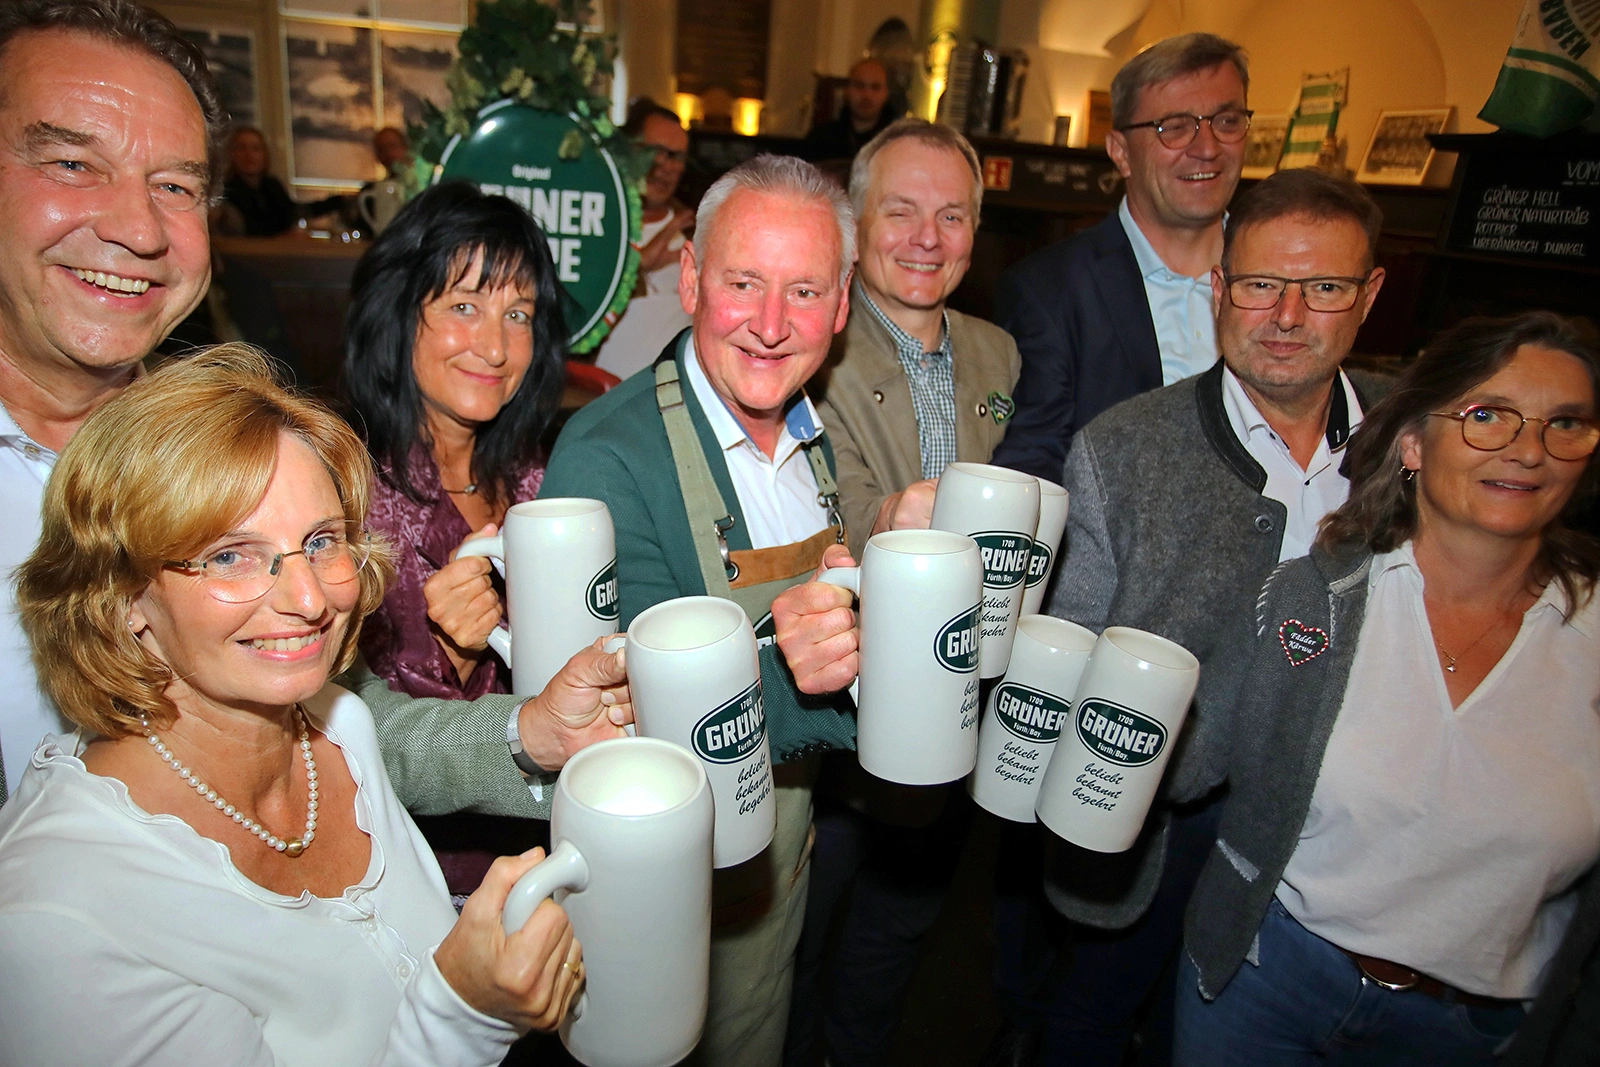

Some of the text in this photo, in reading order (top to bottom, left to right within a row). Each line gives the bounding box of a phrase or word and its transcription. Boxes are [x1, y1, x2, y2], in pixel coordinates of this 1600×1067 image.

[511, 164, 551, 181] Original
[1532, 190, 1560, 207] HELL
[1543, 240, 1586, 257] DUNKEL
[1002, 539, 1015, 548] 1709
[981, 546, 1030, 573] RÜNER
[998, 690, 1068, 731] GRÜNER
[1028, 695, 1044, 706] 1709
[705, 696, 766, 752] GRÜNE
[1081, 706, 1160, 755] GRÜNER
[1117, 714, 1134, 726] 1709
[1003, 741, 1040, 761] beliebt
[997, 752, 1040, 774] bekannt
[1084, 762, 1124, 785] beliebt
[994, 764, 1036, 786] begehrt
[1075, 773, 1123, 799] bekannt
[1071, 787, 1117, 812] begehrt
